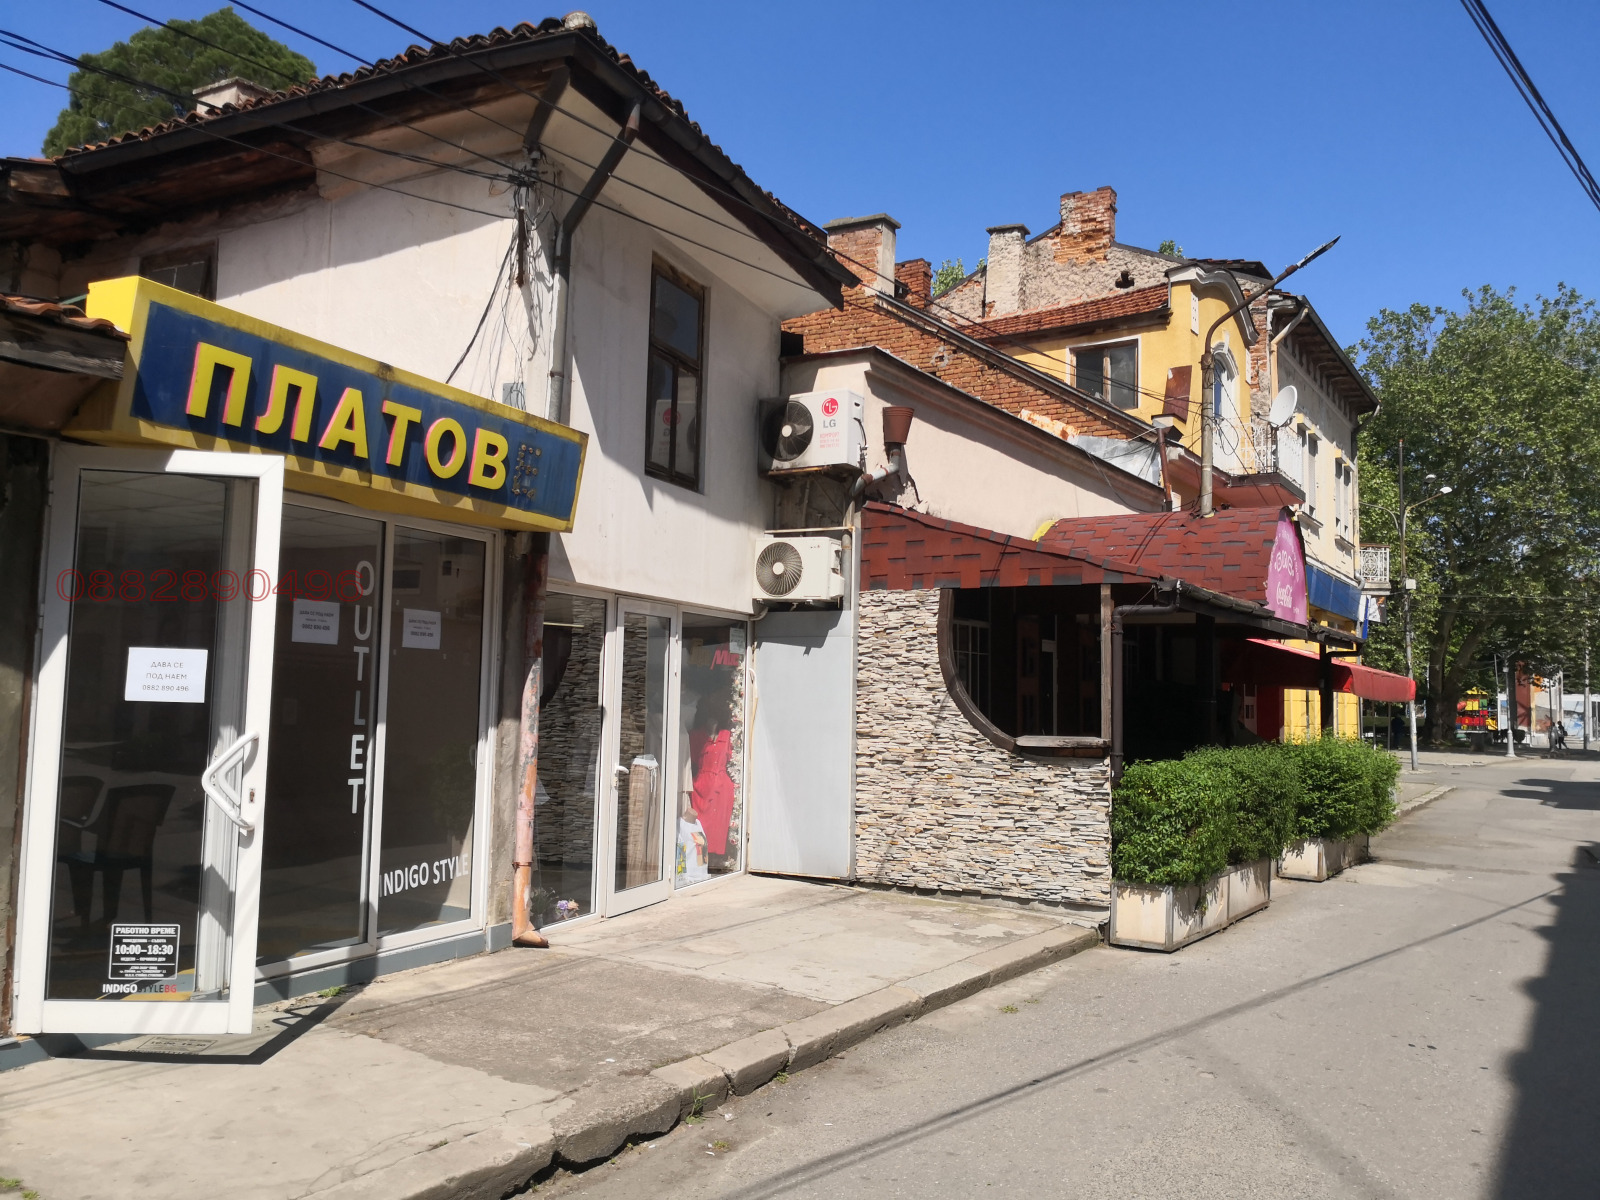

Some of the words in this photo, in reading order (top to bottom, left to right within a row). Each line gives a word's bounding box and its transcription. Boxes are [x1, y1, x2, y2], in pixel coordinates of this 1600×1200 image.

[822, 418, 837, 428] LG
[145, 672, 163, 680] ПОД
[347, 560, 375, 815] OUTLET
[379, 862, 429, 898] INDIGO
[432, 853, 469, 885] STYLE
[115, 926, 150, 934] РАБОТНО
[150, 927, 176, 935] ВРЕМЕ
